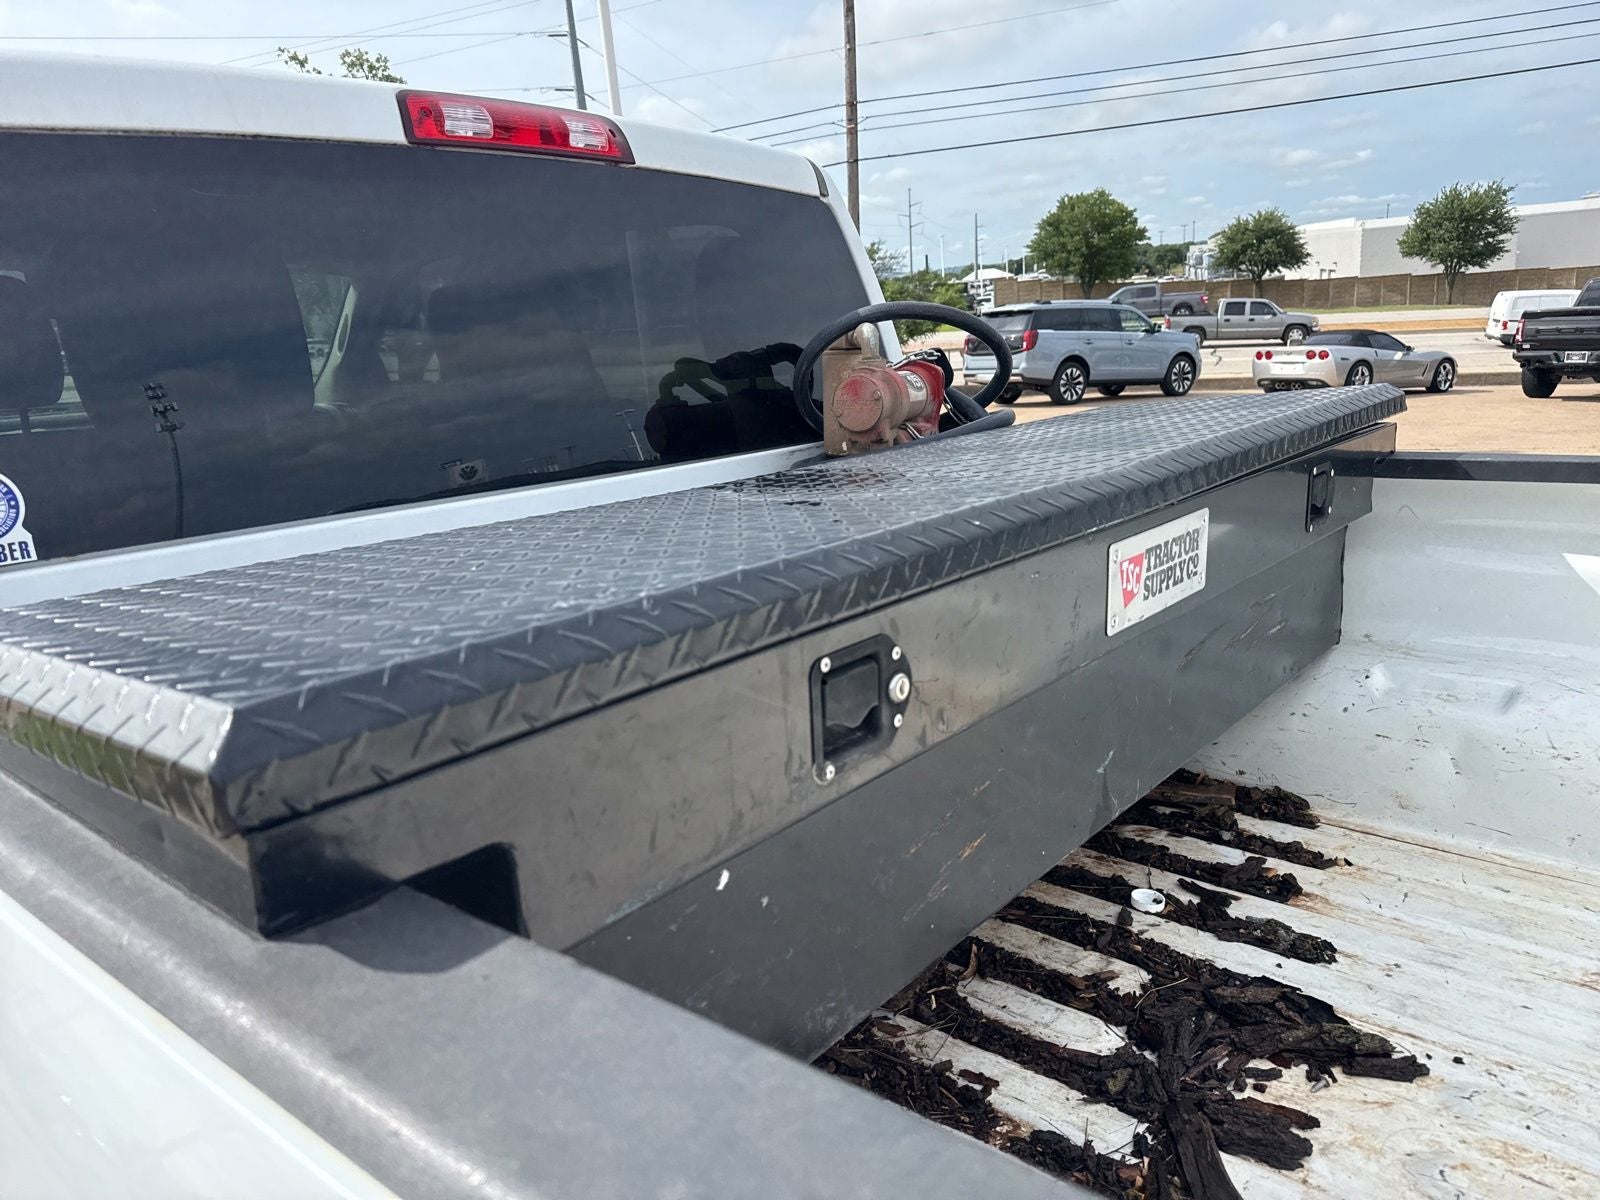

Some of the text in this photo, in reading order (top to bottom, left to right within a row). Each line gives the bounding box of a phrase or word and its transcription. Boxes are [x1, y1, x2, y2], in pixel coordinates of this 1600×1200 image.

[1144, 527, 1200, 573] TRACTOR
[1121, 560, 1140, 594] TSC
[1143, 558, 1187, 601] SUPPLY
